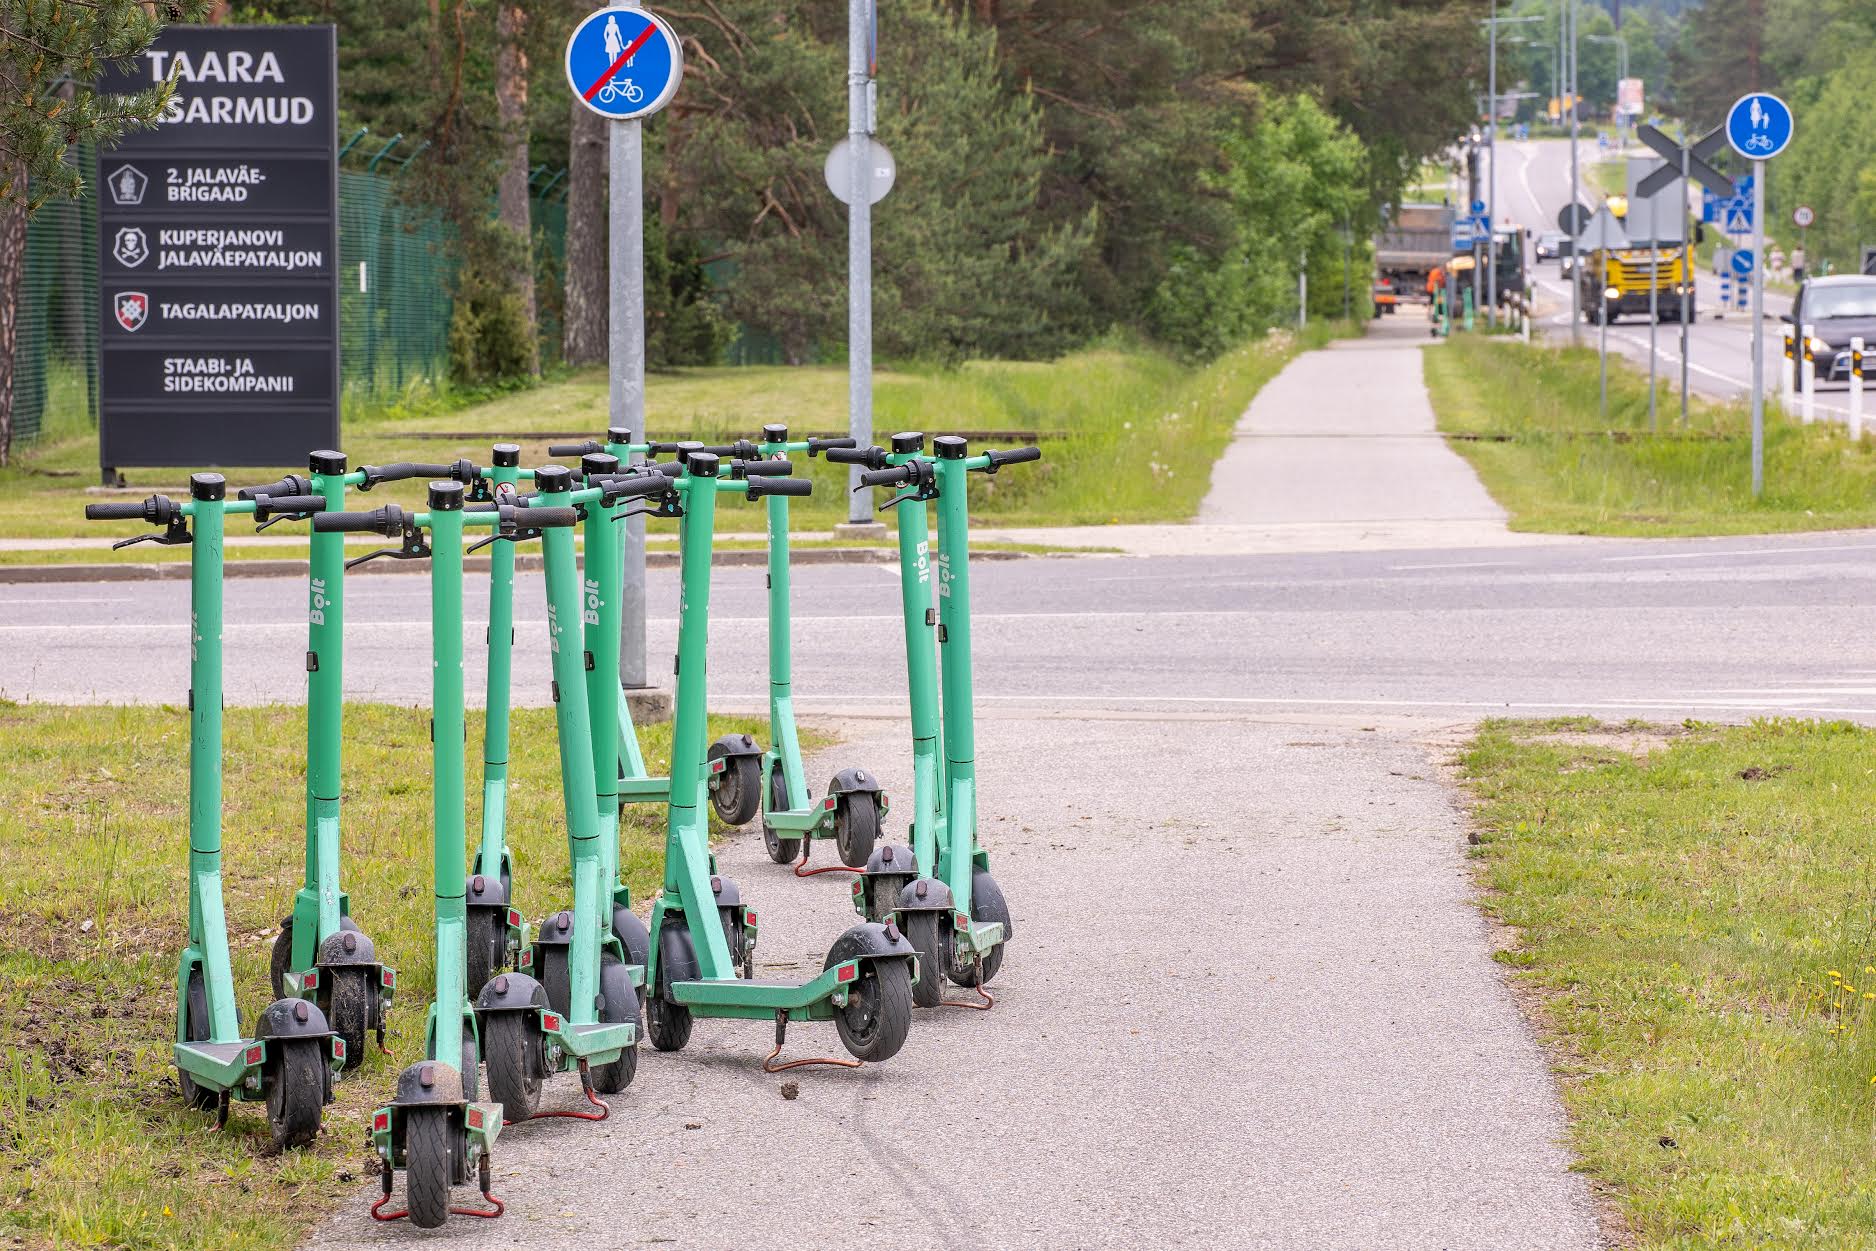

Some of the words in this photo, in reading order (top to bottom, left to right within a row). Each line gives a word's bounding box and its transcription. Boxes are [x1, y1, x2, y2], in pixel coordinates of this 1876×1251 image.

[146, 51, 285, 83] TAARA
[157, 96, 314, 124] SARMUD
[167, 168, 183, 184] 2.
[185, 165, 266, 187] JALAVÄE-
[167, 186, 248, 202] BRIGAAD
[159, 230, 283, 248] KUPERJANOVI
[158, 248, 322, 271] JALAVÄEPATALJON
[160, 304, 319, 323] TAGALAPATALJON
[164, 358, 232, 374] STAABI-
[233, 358, 255, 377] JA
[164, 376, 293, 391] SIDEKOMPANII
[912, 540, 930, 583] Bolt
[939, 553, 955, 598] Bolt
[310, 577, 331, 626] Bolt
[584, 578, 605, 625] Bolt
[548, 603, 563, 654] Bolt
